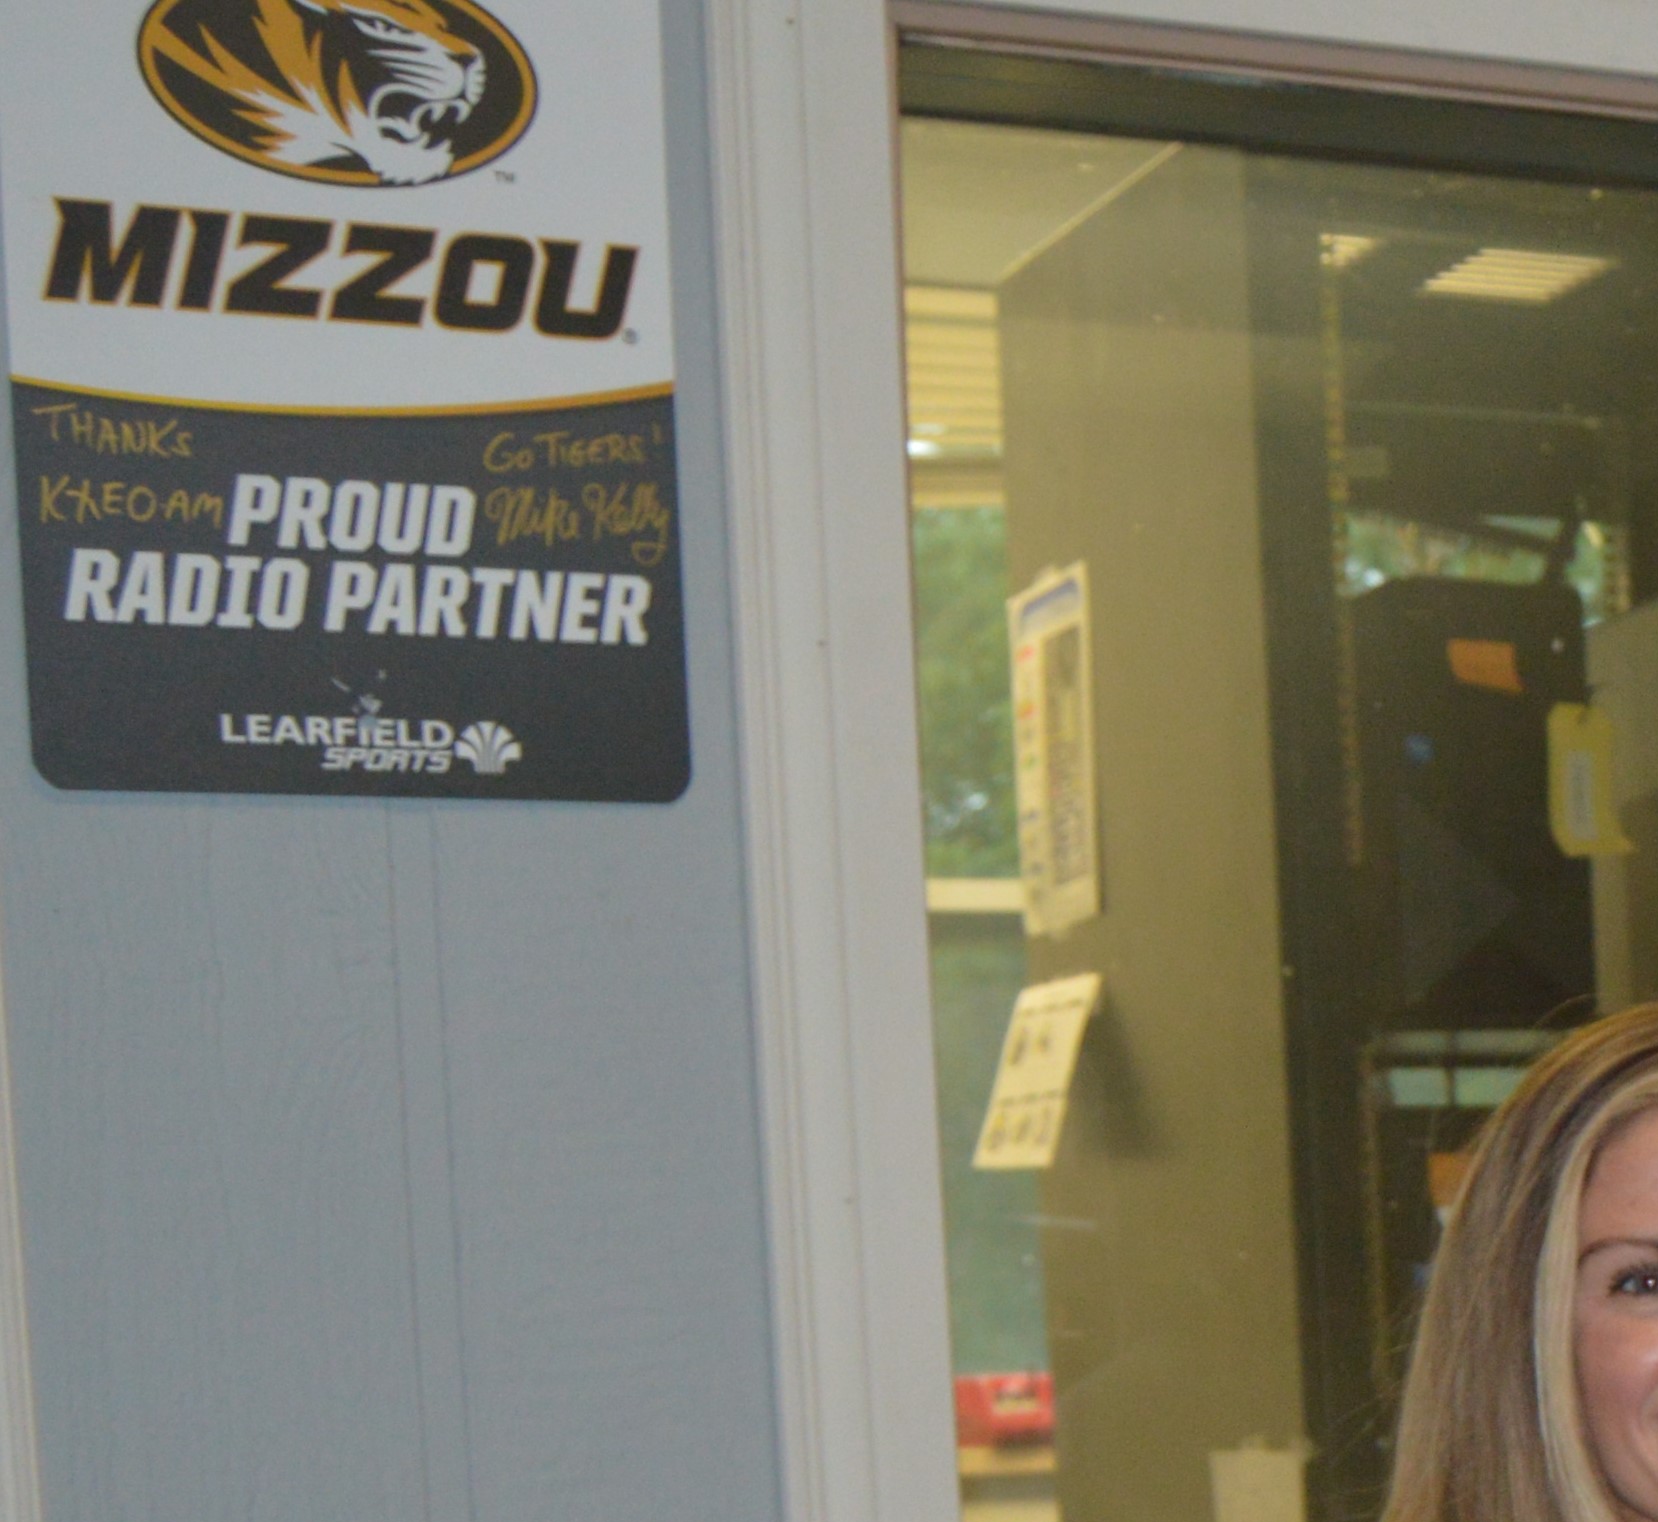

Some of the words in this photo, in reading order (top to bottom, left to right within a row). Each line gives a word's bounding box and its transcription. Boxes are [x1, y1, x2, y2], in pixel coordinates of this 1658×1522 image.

[42, 196, 640, 342] MIZZOU
[31, 402, 194, 458] THANKS
[228, 473, 477, 557] PROUD
[64, 547, 310, 631] RADIO
[323, 560, 653, 646] PARTNER
[219, 712, 454, 750] LEARFIELD
[320, 747, 452, 774] SPORTS
